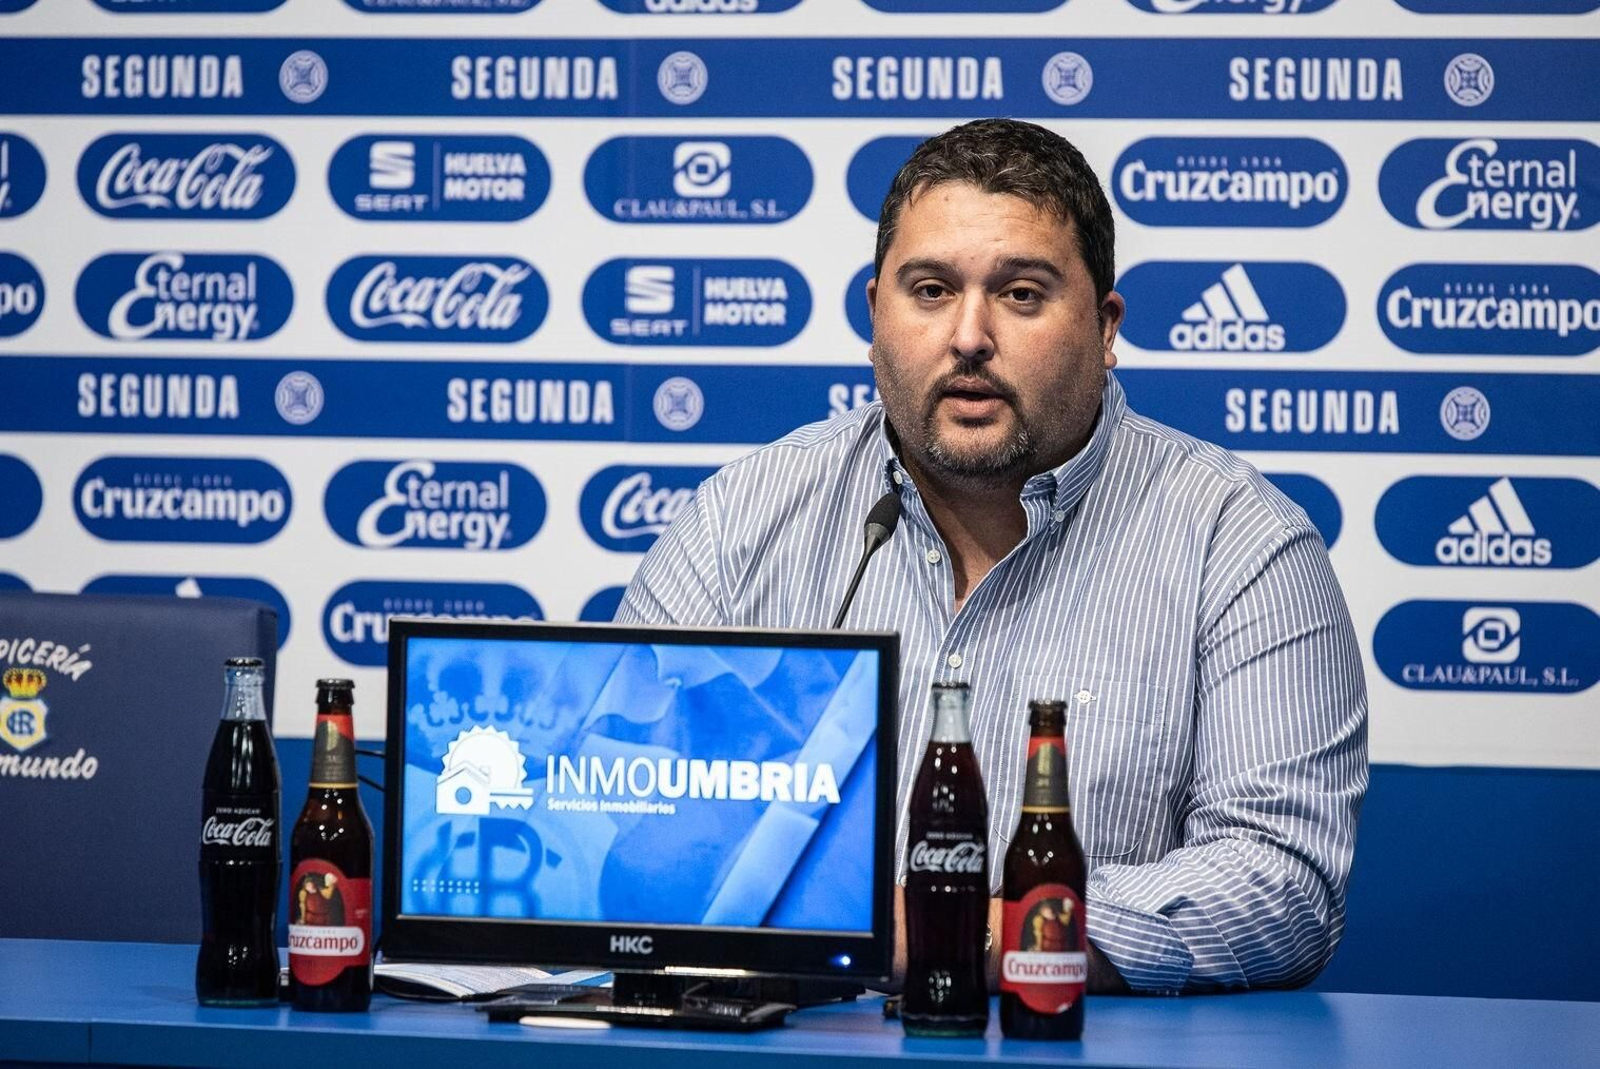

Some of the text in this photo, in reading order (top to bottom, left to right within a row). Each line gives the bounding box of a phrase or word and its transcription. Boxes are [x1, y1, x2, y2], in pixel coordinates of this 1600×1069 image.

[81, 54, 244, 98] SEGUNDA
[451, 55, 619, 100] SEGUNDA
[832, 56, 1004, 101] SEGUNDA
[1229, 57, 1403, 102] SEGUNDA
[444, 152, 527, 176] HUELVA
[1119, 158, 1340, 209] Cruzcampo
[354, 193, 428, 212] SEAT
[443, 177, 525, 201] MOTOR
[704, 277, 788, 301] HUELVA
[1386, 285, 1600, 337] Cruzcampo
[610, 318, 688, 337] SEAT
[703, 301, 787, 326] MOTOR
[1169, 318, 1286, 351] adidas
[77, 373, 240, 419] SEGUNDA
[447, 378, 614, 424] SEGUNDA
[1225, 388, 1400, 434] SEGUNDA
[81, 476, 285, 528] Cruzcampo
[1434, 532, 1553, 566] adidas
[547, 755, 840, 804] INMOUMBRIA
[547, 799, 676, 815] Servicios Inmobiliarios
[610, 935, 653, 955] HKC
